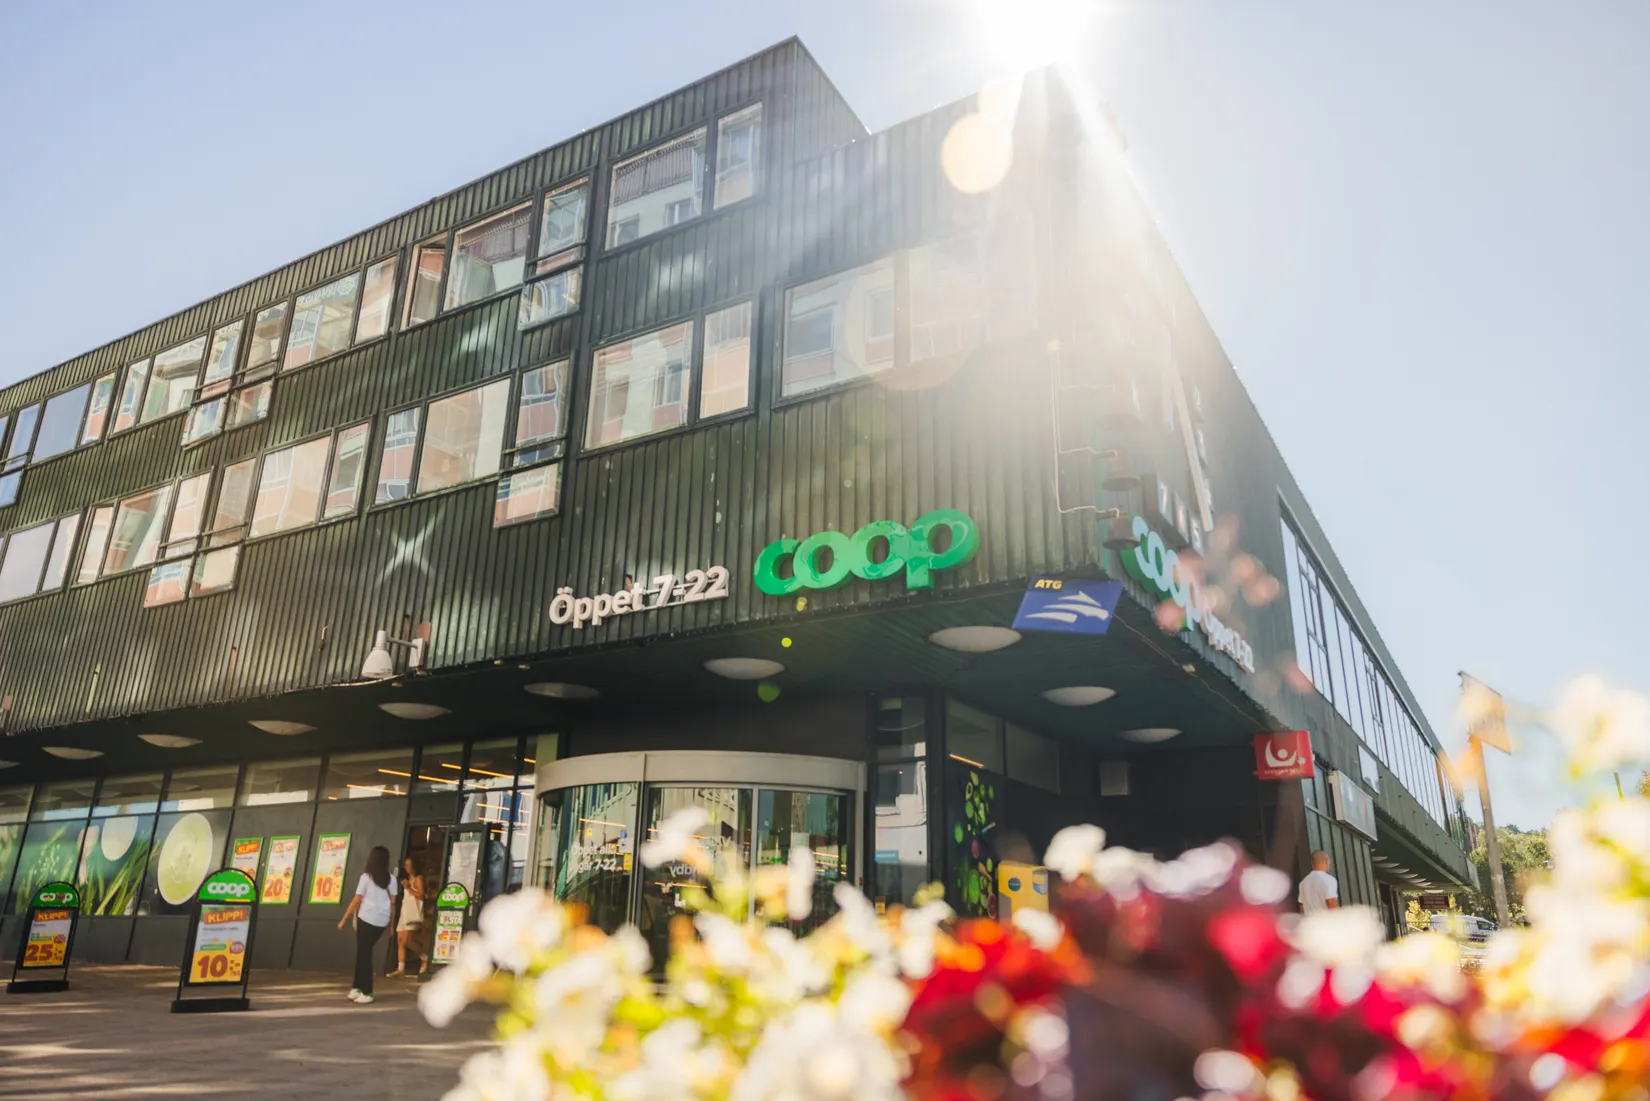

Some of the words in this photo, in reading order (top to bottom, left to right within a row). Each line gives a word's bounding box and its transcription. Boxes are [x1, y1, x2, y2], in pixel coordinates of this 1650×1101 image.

[754, 509, 980, 595] coop
[1034, 579, 1063, 590] ATG
[1121, 516, 1202, 631] coop
[549, 586, 645, 629] Öppet
[653, 566, 729, 608] 7-22
[207, 882, 250, 897] coop
[208, 911, 244, 924] KLIPP!
